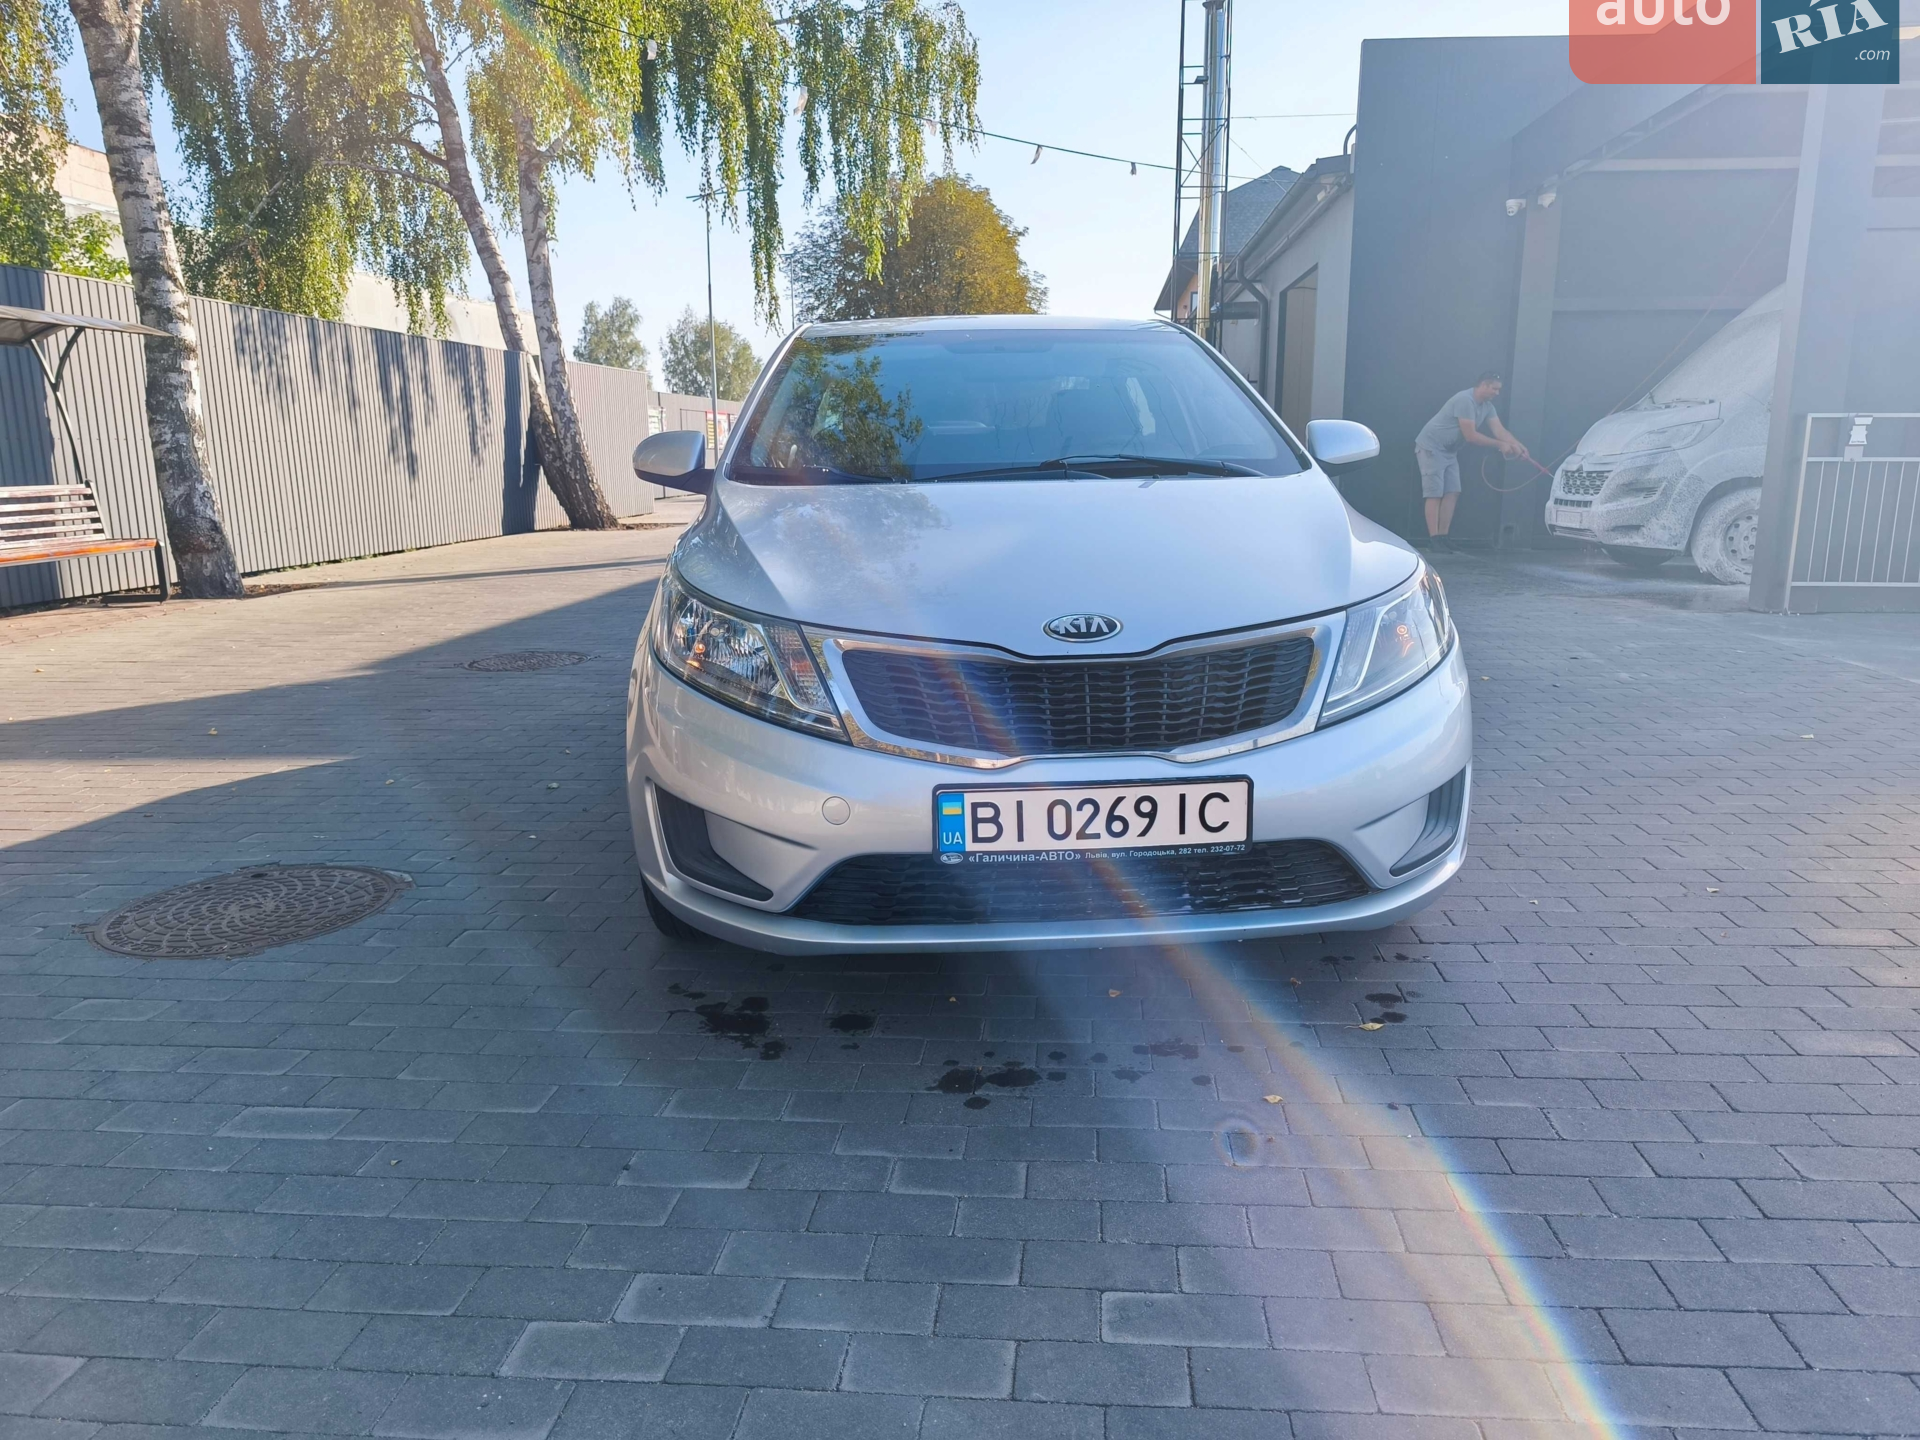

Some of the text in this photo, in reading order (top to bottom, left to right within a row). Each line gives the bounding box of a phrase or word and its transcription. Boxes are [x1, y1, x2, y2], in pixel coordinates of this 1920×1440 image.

[1057, 617, 1110, 635] KIA
[970, 791, 1231, 844] BI 0269 IC
[942, 831, 964, 845] UA
[968, 850, 1082, 864] «Галичина-АВТО»
[1084, 851, 1110, 860] Львів,
[1111, 851, 1128, 859] вул.
[1129, 848, 1177, 858] Городоцька,
[1178, 847, 1192, 855] 282
[1210, 843, 1246, 854] 232-07-72
